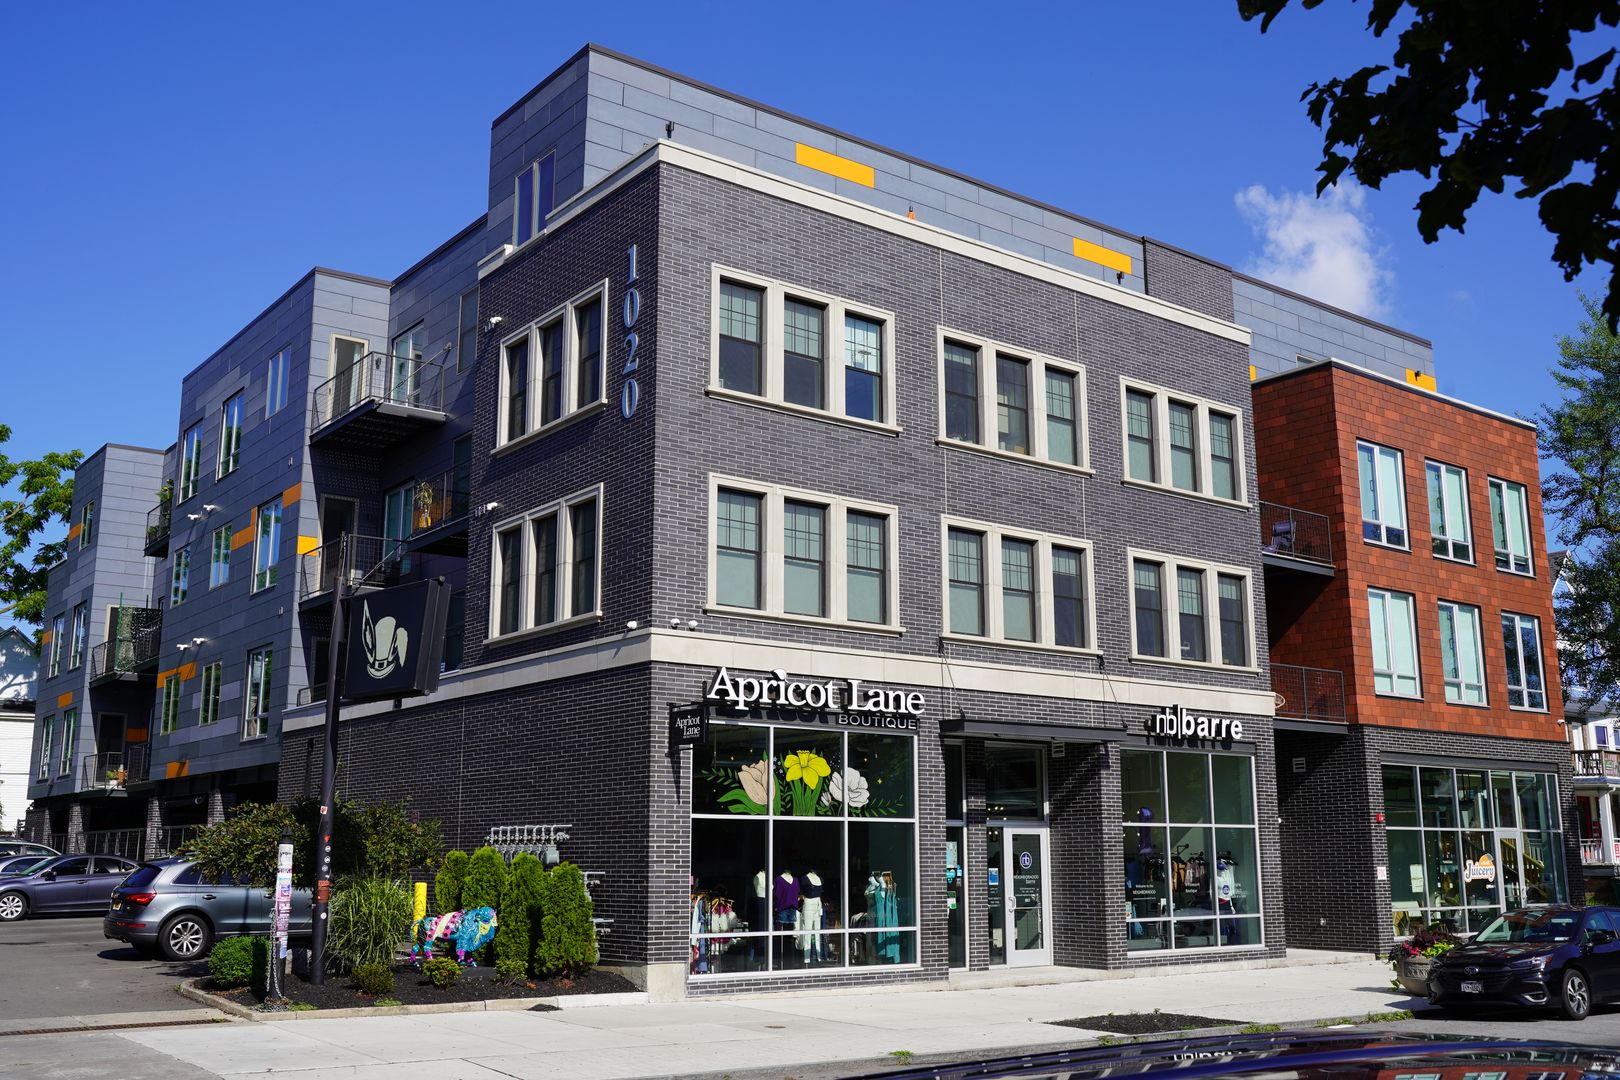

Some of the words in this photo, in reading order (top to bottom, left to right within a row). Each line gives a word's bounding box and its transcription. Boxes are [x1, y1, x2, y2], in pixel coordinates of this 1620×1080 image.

[621, 244, 640, 419] 1020
[706, 666, 839, 710] Apricot
[846, 679, 926, 715] Lane
[675, 715, 701, 729] Apricot
[838, 714, 918, 730] BOUTIQUE
[683, 726, 701, 736] Lane
[1465, 862, 1495, 880] Juicery
